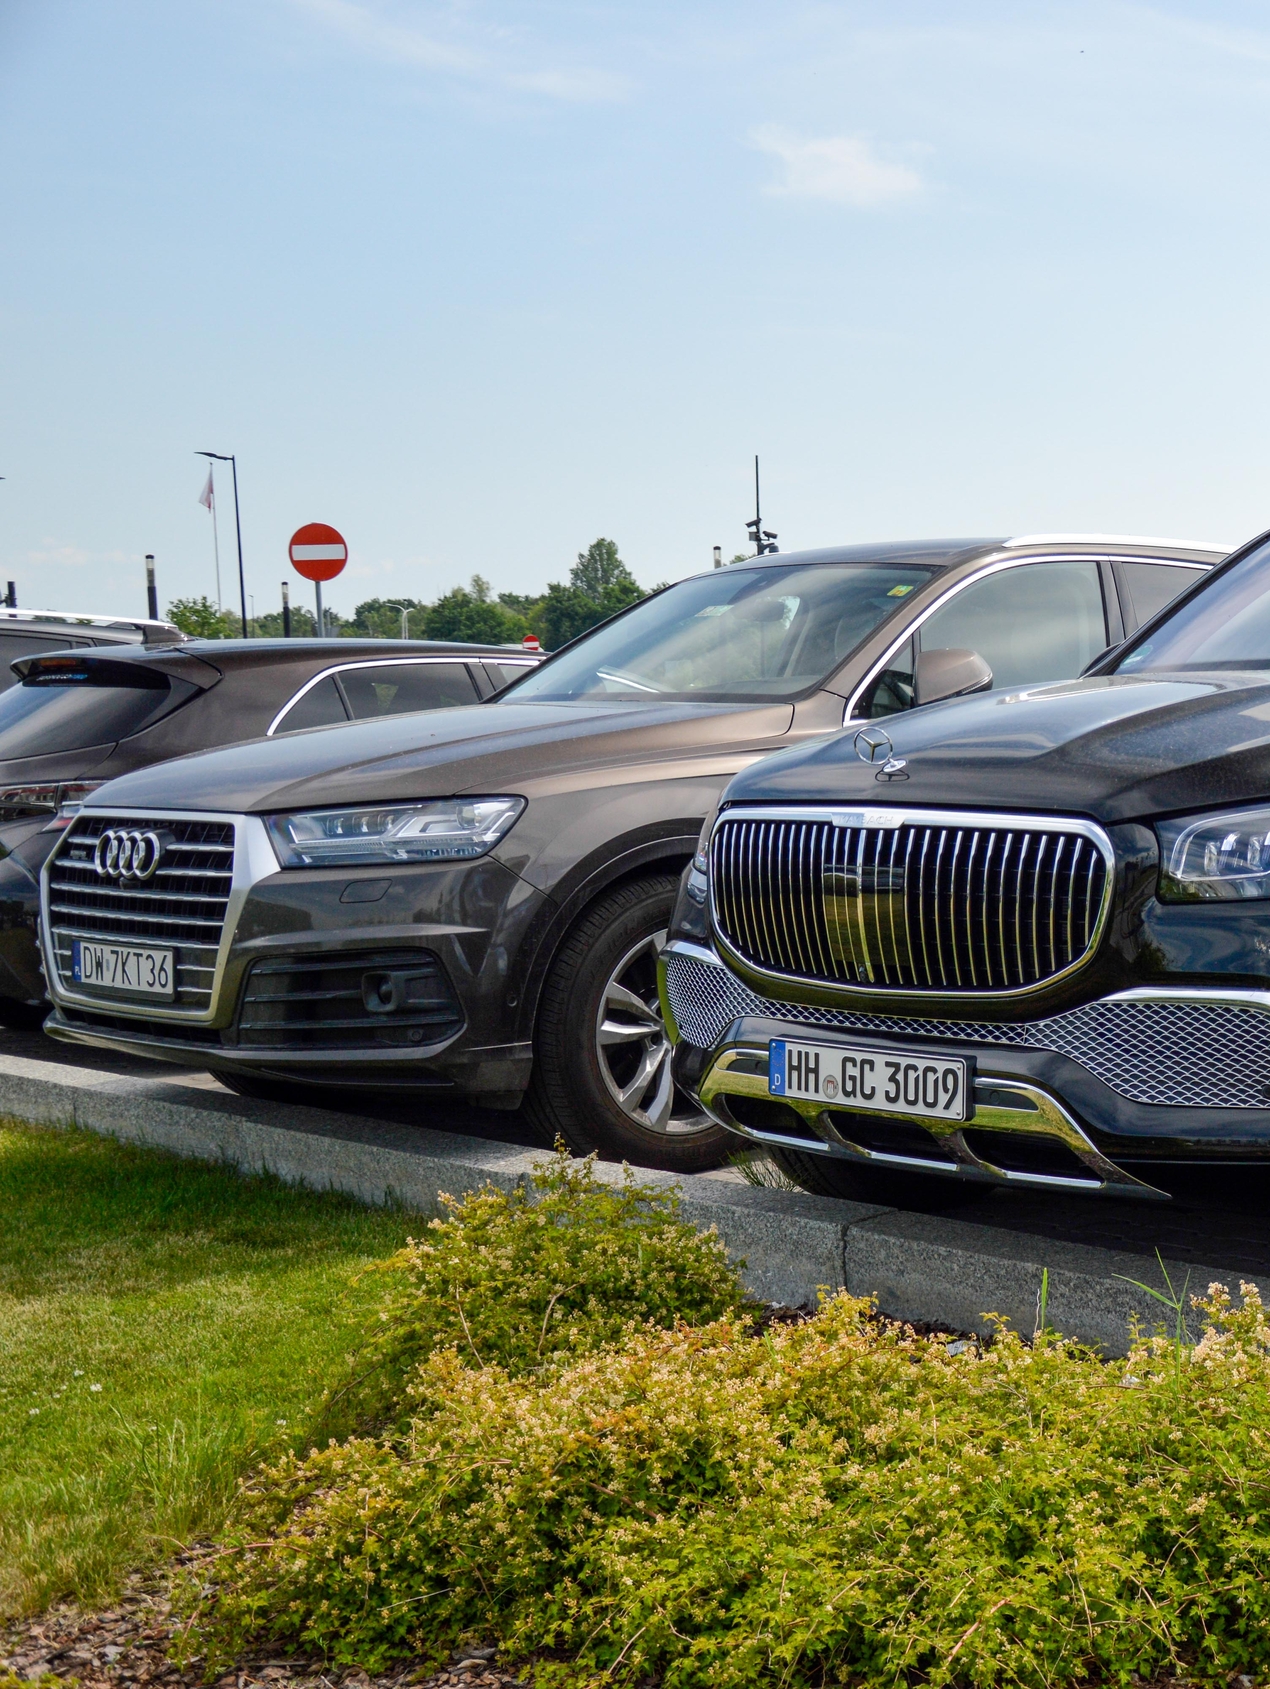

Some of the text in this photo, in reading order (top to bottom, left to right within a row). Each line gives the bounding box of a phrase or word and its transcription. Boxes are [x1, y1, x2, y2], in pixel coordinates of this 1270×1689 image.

[838, 814, 894, 825] MAYBACH
[74, 965, 81, 976] PL
[83, 945, 169, 989] DW 7KT36
[774, 1073, 781, 1086] D
[787, 1048, 960, 1111] HH GC 3009
